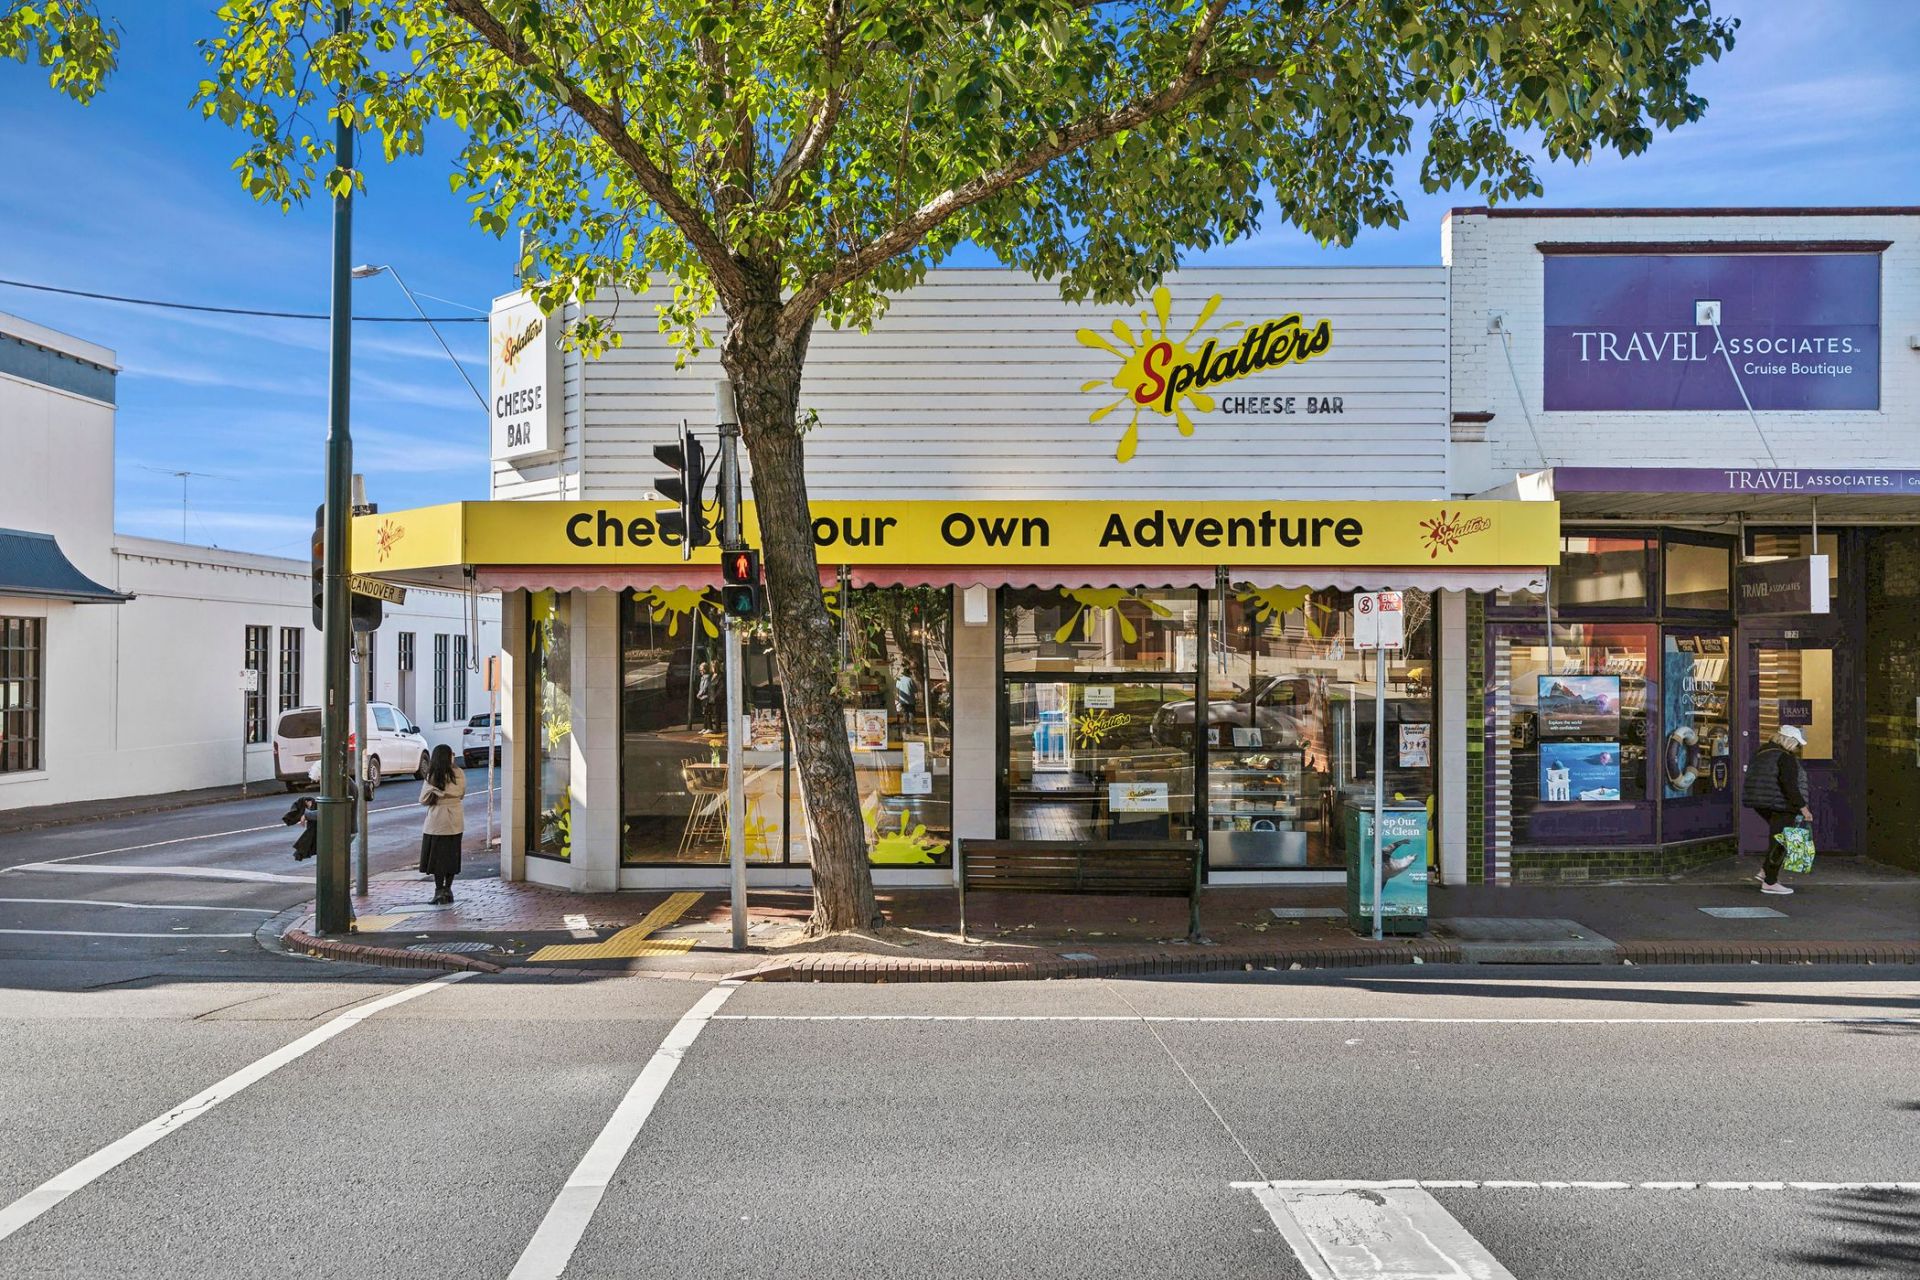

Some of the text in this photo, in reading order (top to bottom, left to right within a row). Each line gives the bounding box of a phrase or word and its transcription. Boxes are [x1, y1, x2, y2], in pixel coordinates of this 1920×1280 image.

[504, 319, 543, 365] Splatters
[1572, 332, 1707, 361] TRAVEL
[1712, 338, 1853, 354] ASSOCIATES
[1134, 314, 1330, 413] Splatters
[1744, 362, 1853, 377] Cruise Boutique
[496, 385, 542, 418] CHEESE
[1222, 397, 1344, 414] CHEESE BAR
[507, 421, 531, 448] BAR
[1724, 471, 1890, 489] TRAVEL ASSOCIATES
[811, 517, 898, 546] our
[941, 512, 1050, 547] Own
[1099, 510, 1364, 548] Adventure
[1435, 516, 1492, 546] Splatters
[351, 577, 395, 600] CANDOVER
[1741, 582, 1769, 598] TRAVEL
[1085, 714, 1131, 736] Splatters
[1367, 826, 1420, 836] Bs Clean
[1397, 816, 1416, 827] Our
